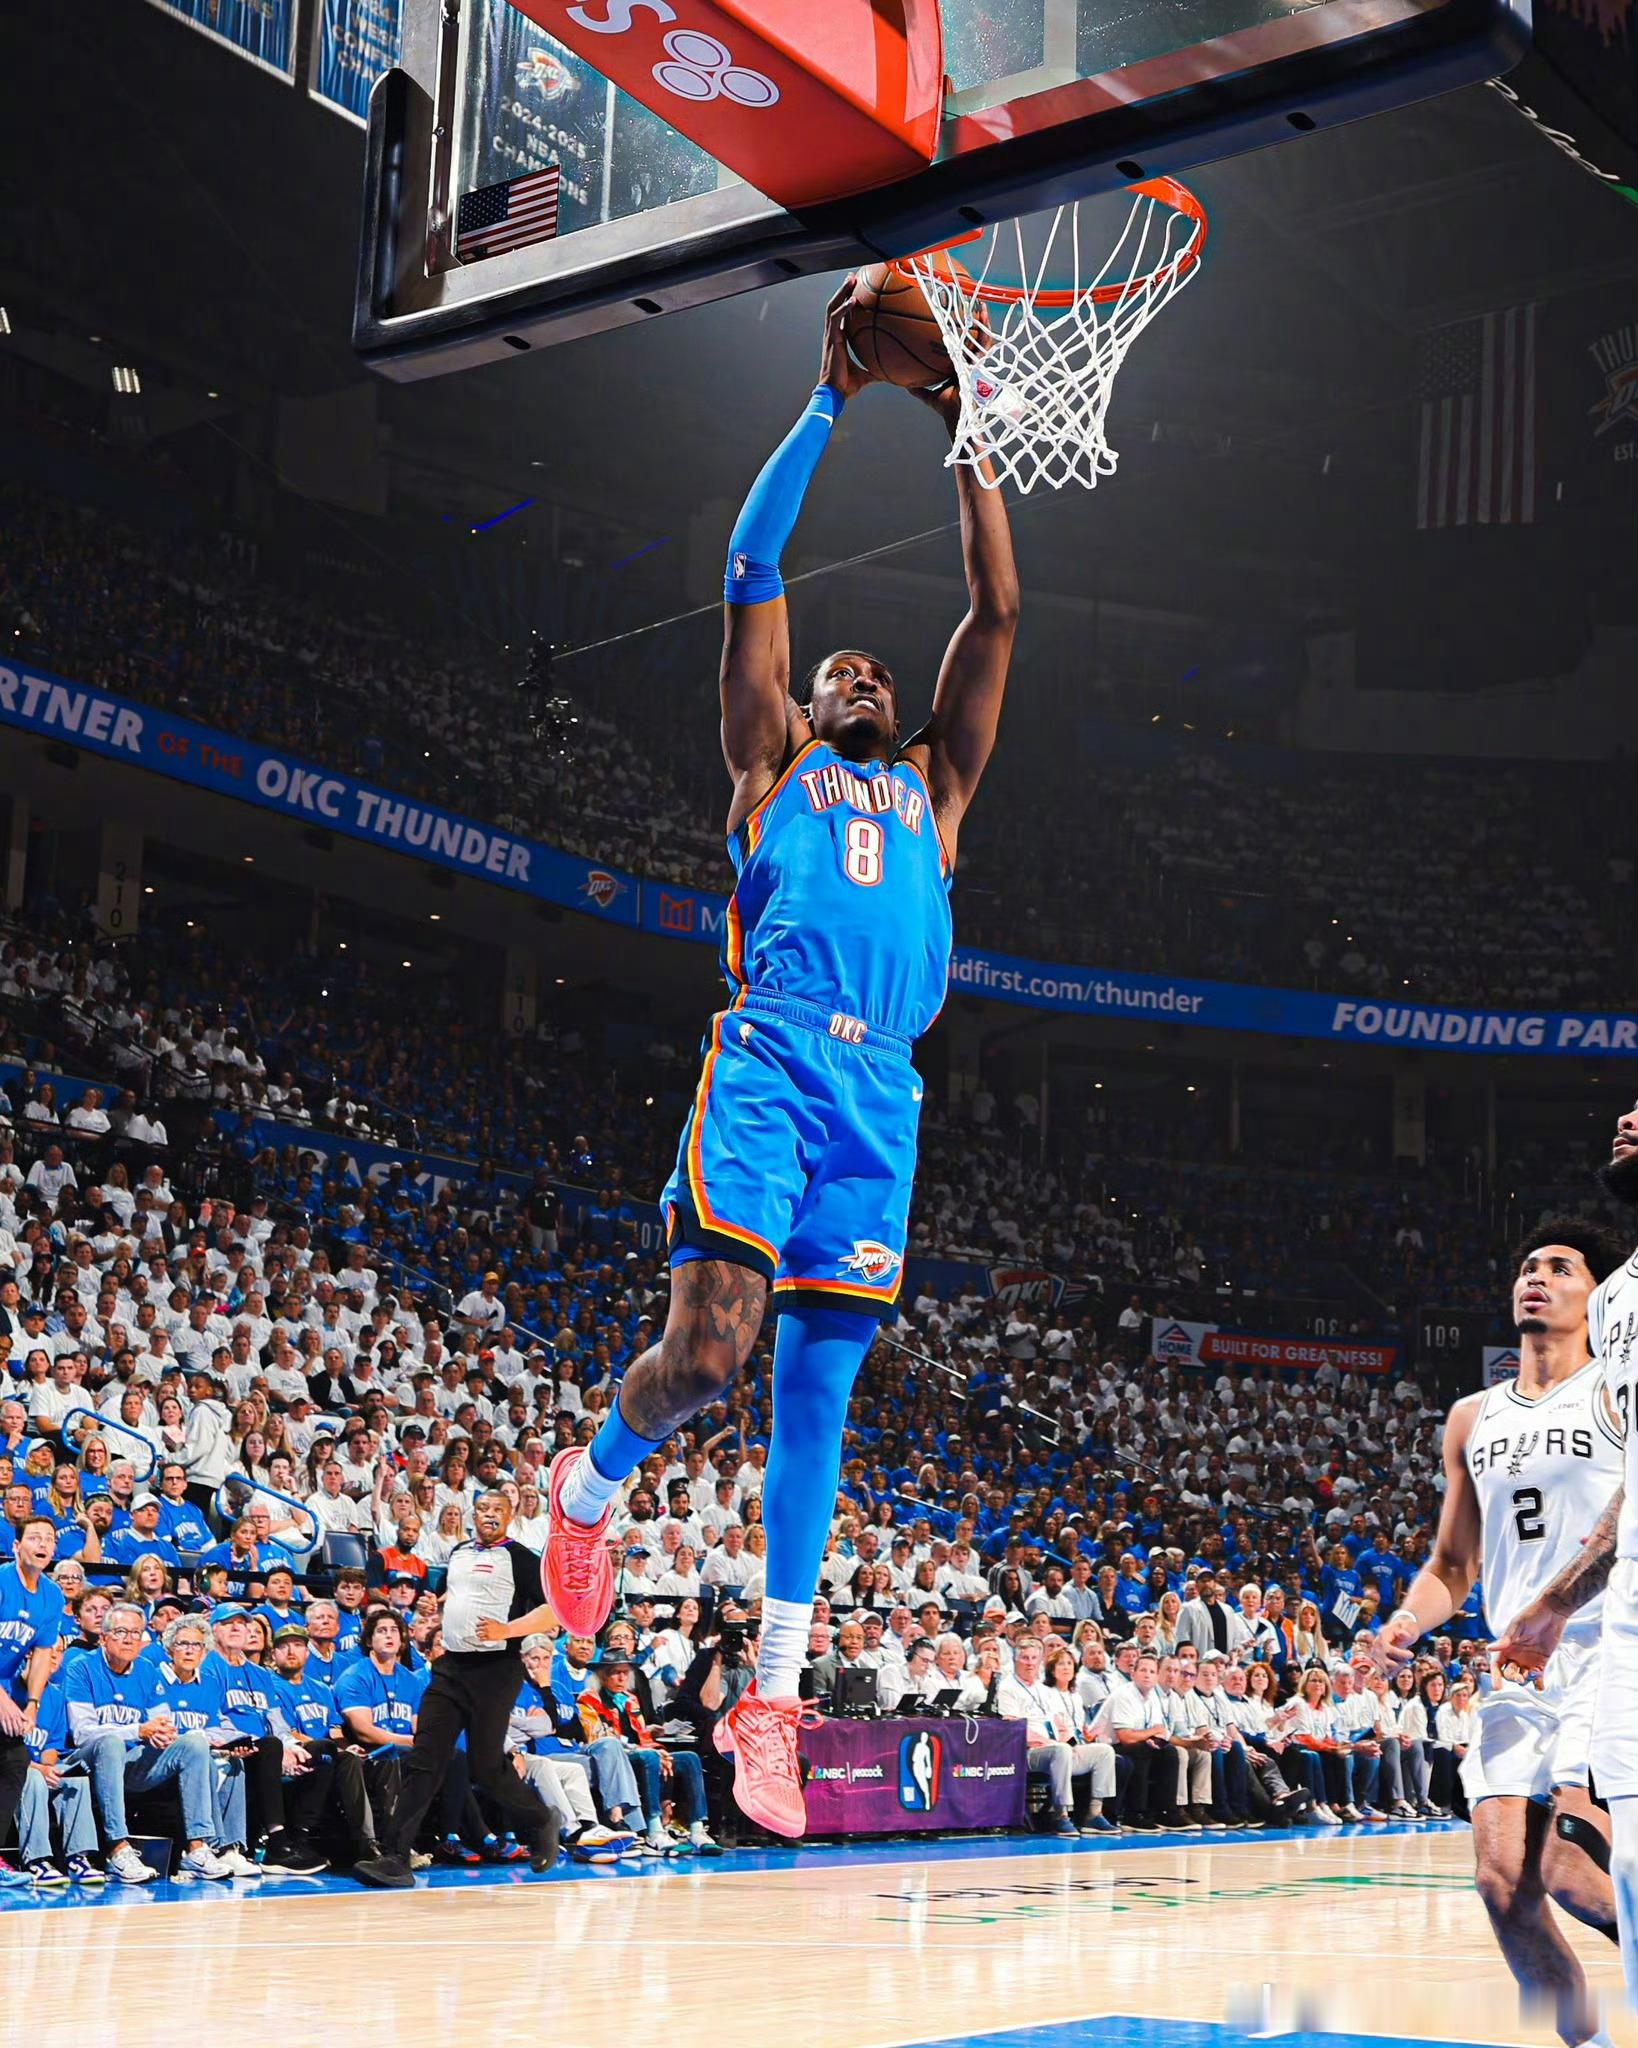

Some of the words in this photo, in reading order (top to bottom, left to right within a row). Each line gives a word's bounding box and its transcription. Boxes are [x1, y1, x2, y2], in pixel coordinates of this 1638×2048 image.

[500, 95, 587, 160] 2024-2025
[525, 133, 561, 167] NBA
[157, 731, 191, 758] OF
[198, 745, 244, 778] THE
[256, 758, 346, 818] OKC
[355, 790, 532, 883] THUNDER
[799, 763, 925, 836] THUNDER
[844, 817, 885, 887] 8
[827, 1011, 868, 1045] OKC
[1331, 1002, 1546, 1047] FOUNDING
[1556, 1018, 1638, 1049] PAR
[854, 1250, 888, 1270] OKC
[1157, 1340, 1193, 1356] HOME
[1211, 1338, 1248, 1356] BUILT
[1250, 1343, 1281, 1359] FOR
[1423, 1324, 1461, 1349] 109
[1472, 1428, 1593, 1479] SPURS
[1512, 1487, 1548, 1545] 2
[822, 1767, 846, 1780] NBC
